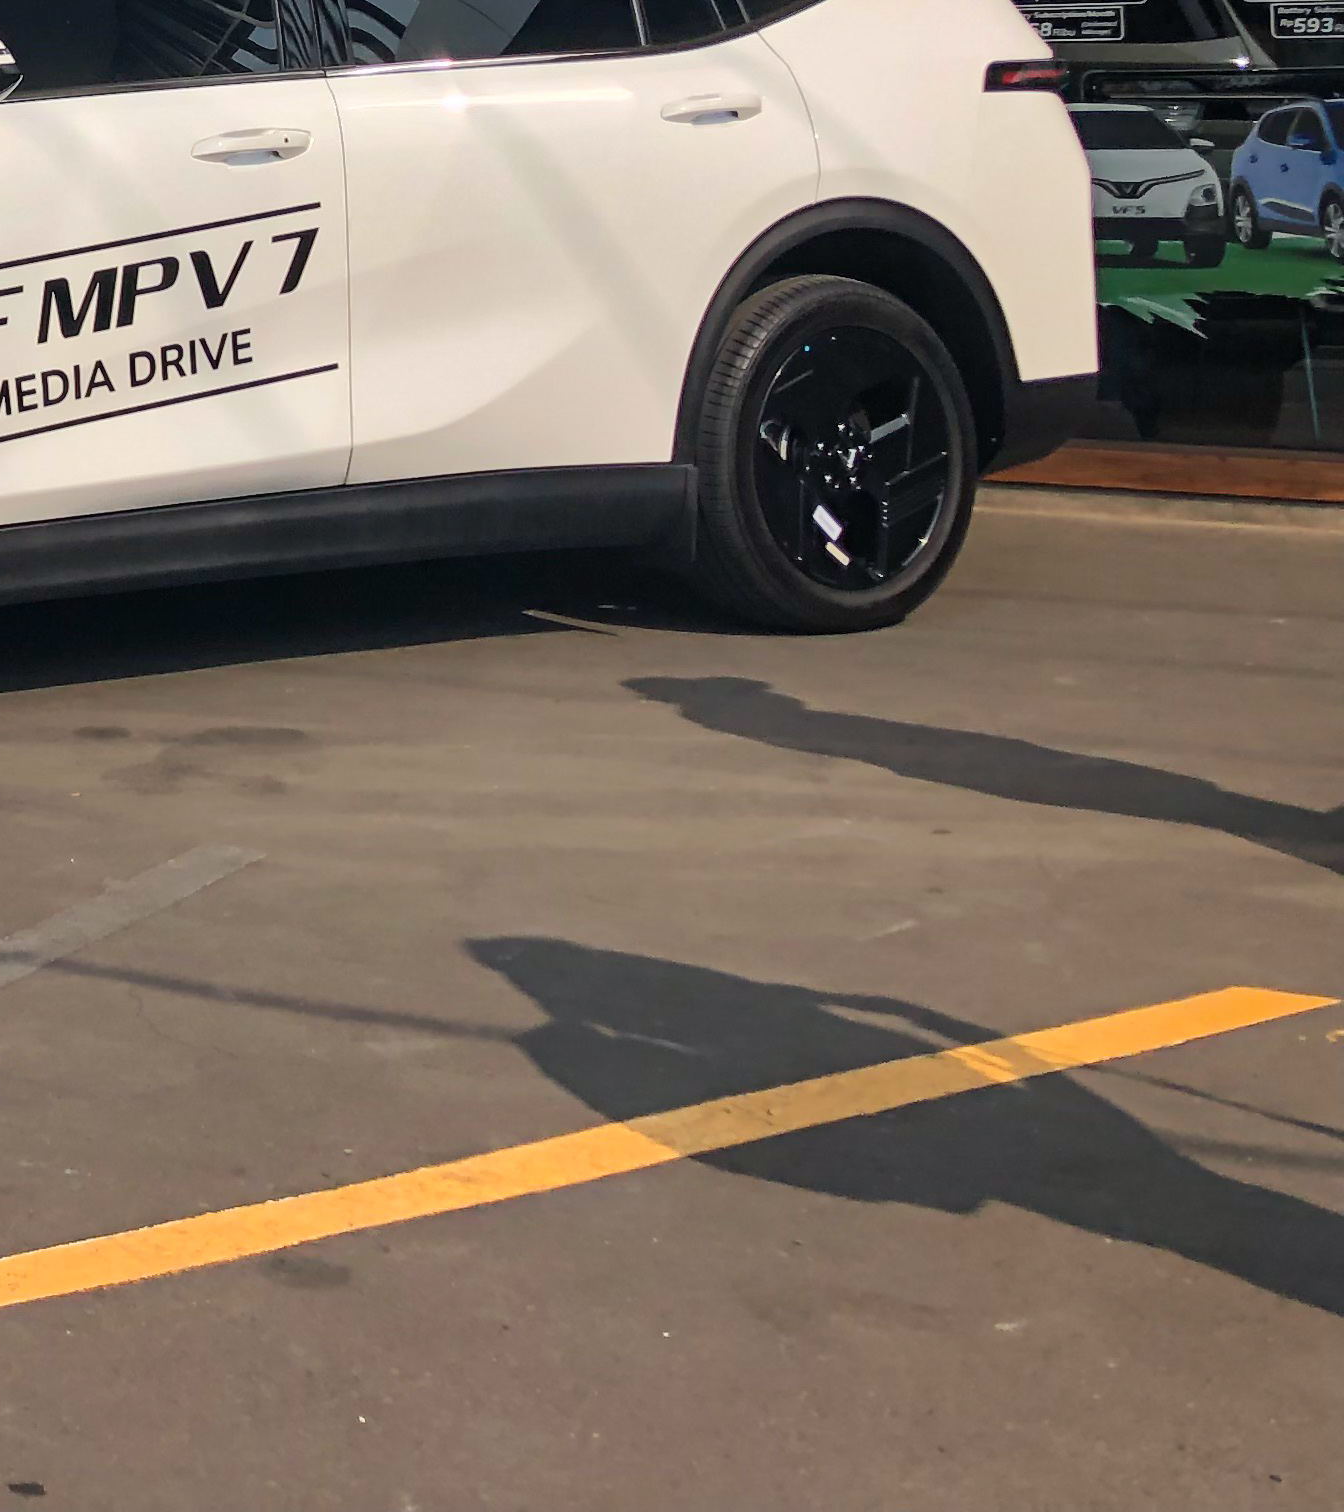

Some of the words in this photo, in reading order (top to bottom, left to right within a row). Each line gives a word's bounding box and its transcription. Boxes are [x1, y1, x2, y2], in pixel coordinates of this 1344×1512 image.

[37, 240, 254, 345] MPV
[271, 227, 320, 296] 7
[128, 327, 253, 388] DRIVE
